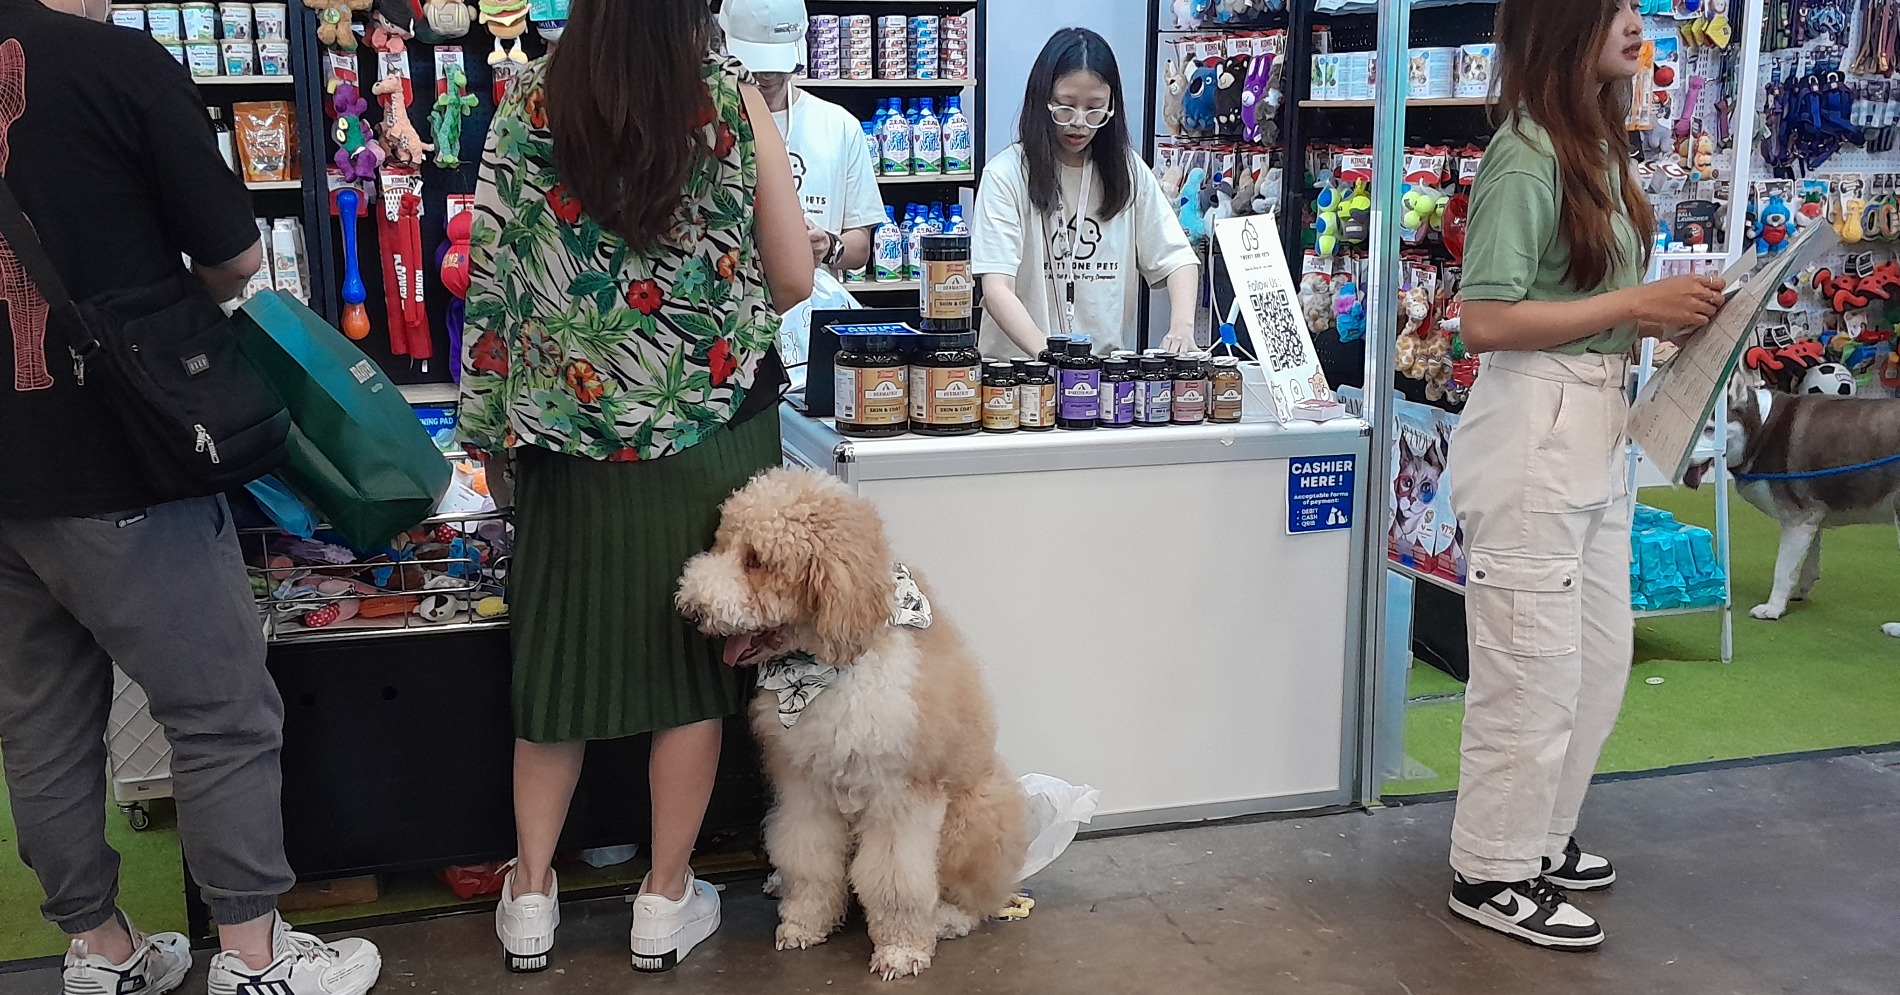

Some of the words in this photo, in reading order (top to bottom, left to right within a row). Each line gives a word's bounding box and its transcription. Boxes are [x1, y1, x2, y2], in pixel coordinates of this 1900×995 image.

[1247, 280, 1268, 291] Follow
[1268, 276, 1278, 288] Us
[1292, 460, 1352, 474] CASHIER
[1300, 475, 1336, 488] HERE
[1338, 474, 1343, 486] !
[512, 954, 547, 970] PUMA
[632, 954, 662, 970] PUMA
